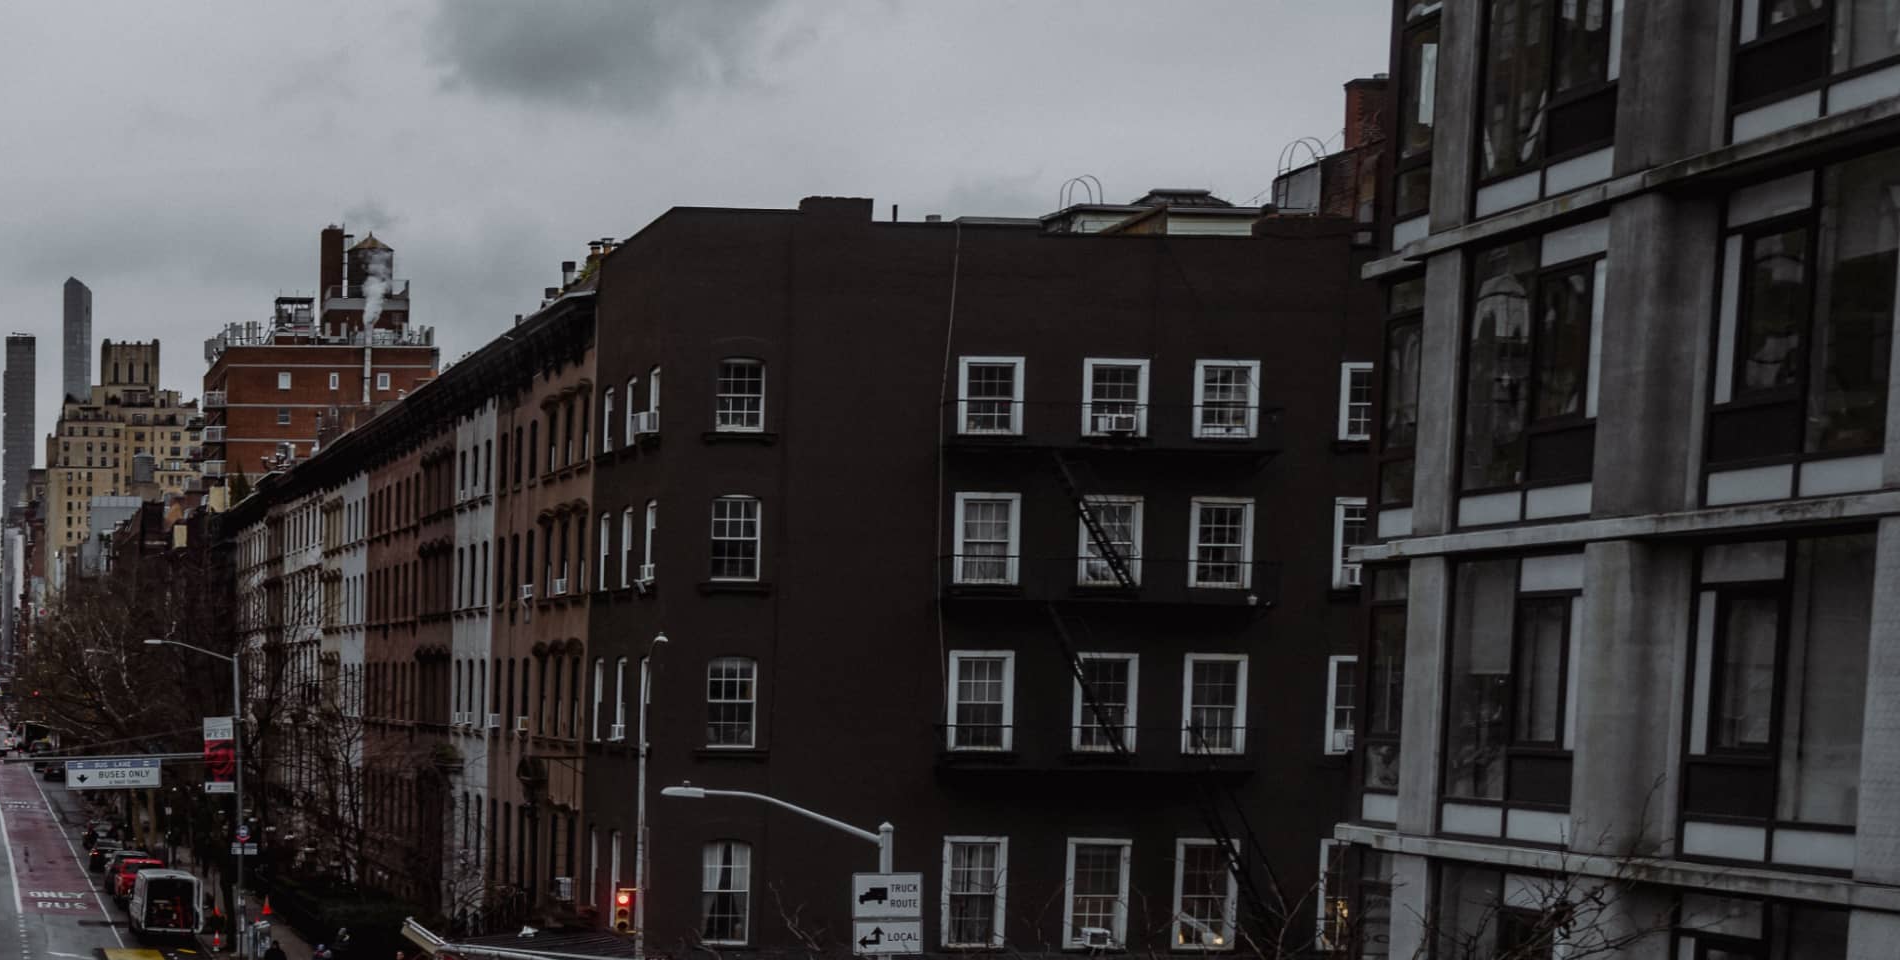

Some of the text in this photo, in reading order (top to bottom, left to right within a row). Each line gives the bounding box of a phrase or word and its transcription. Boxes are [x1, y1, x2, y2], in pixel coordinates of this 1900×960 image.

[98, 770, 150, 779] BUSES ONLY
[890, 884, 918, 893] TRUCK
[890, 899, 918, 908] ROUTE
[887, 932, 919, 942] LOCAL
